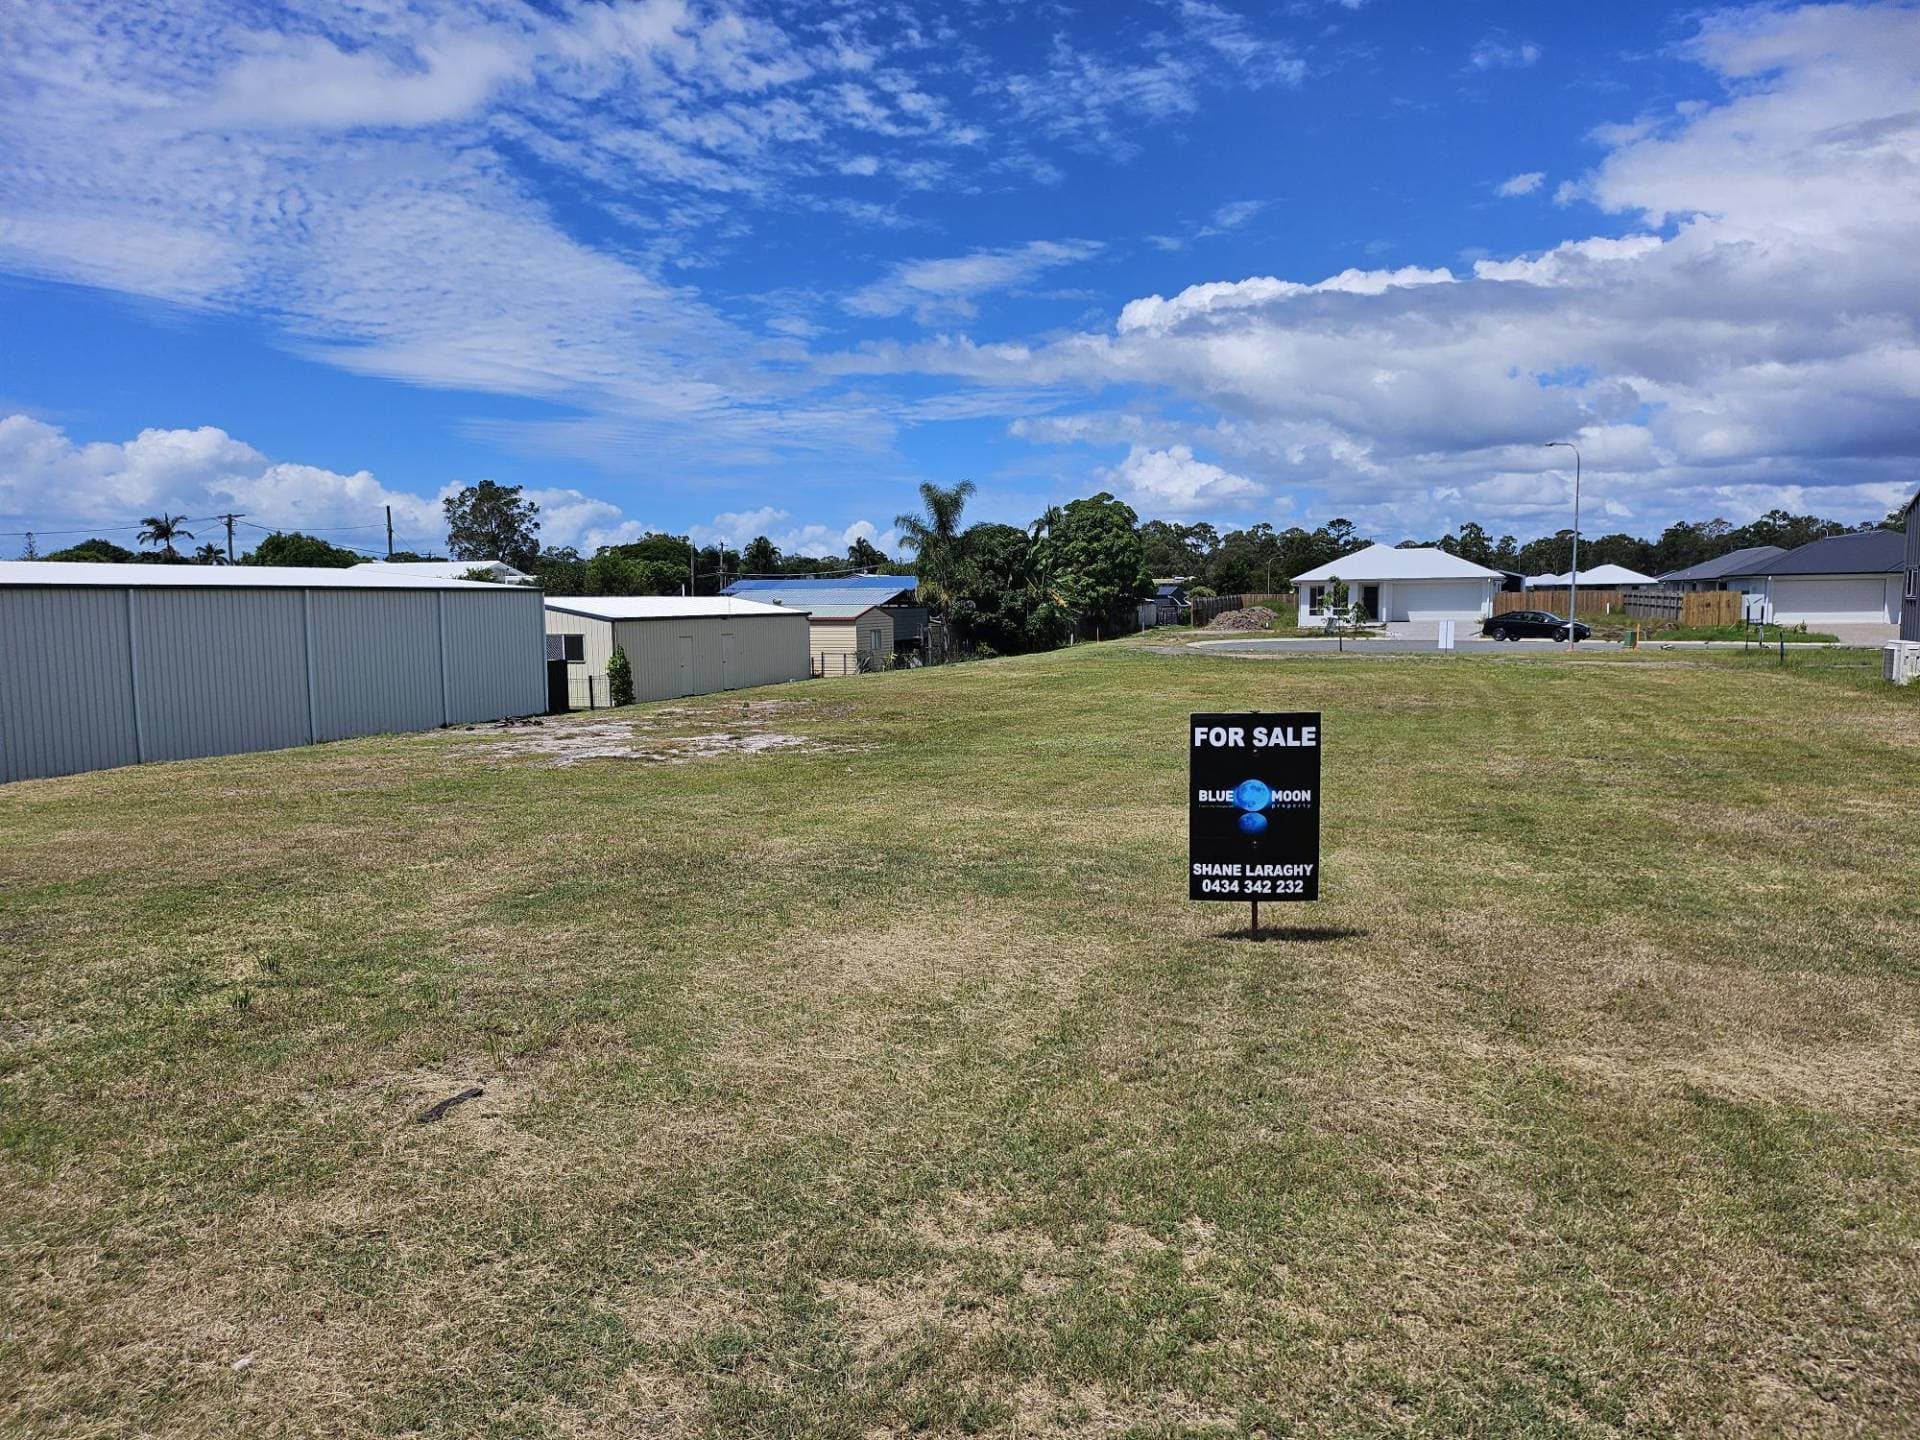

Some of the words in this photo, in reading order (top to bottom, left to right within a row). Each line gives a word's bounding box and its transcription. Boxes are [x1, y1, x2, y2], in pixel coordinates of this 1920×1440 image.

[1194, 727, 1245, 747] FOR
[1252, 727, 1317, 747] SALE
[1199, 790, 1234, 802] BLUE
[1271, 790, 1311, 802] MOON
[1193, 863, 1242, 876] SHANE
[1245, 864, 1314, 876] LARAGHY
[1202, 879, 1239, 893] 0434
[1243, 880, 1272, 893] 342
[1276, 880, 1304, 893] 232
